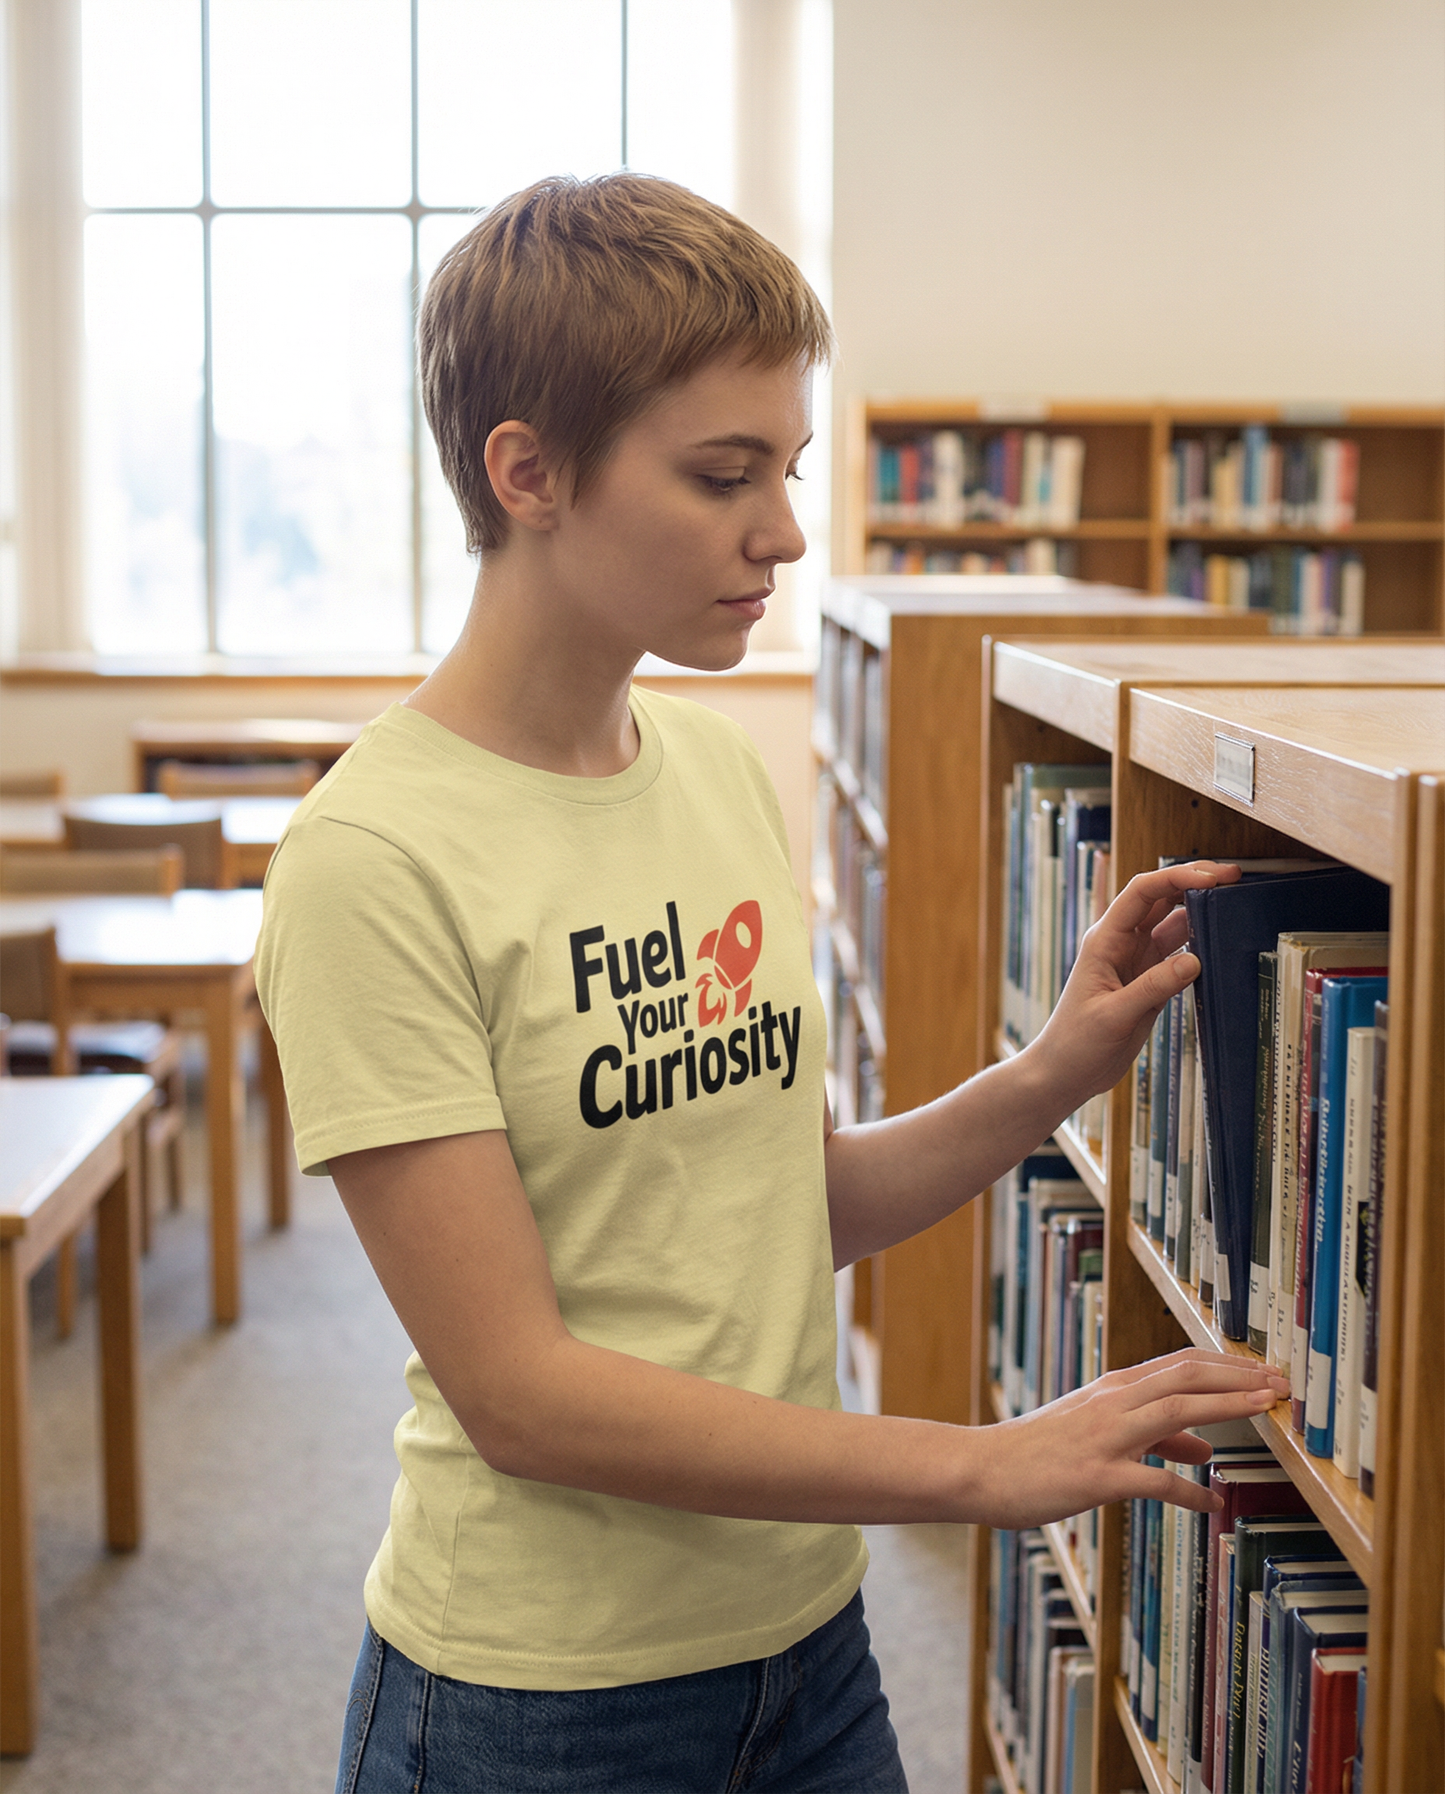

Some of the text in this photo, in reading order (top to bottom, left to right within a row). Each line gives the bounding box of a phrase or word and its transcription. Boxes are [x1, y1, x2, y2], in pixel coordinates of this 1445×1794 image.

[569, 900, 686, 1013] Fuel
[579, 1000, 801, 1130] Curiosity
[617, 993, 689, 1056] Your
